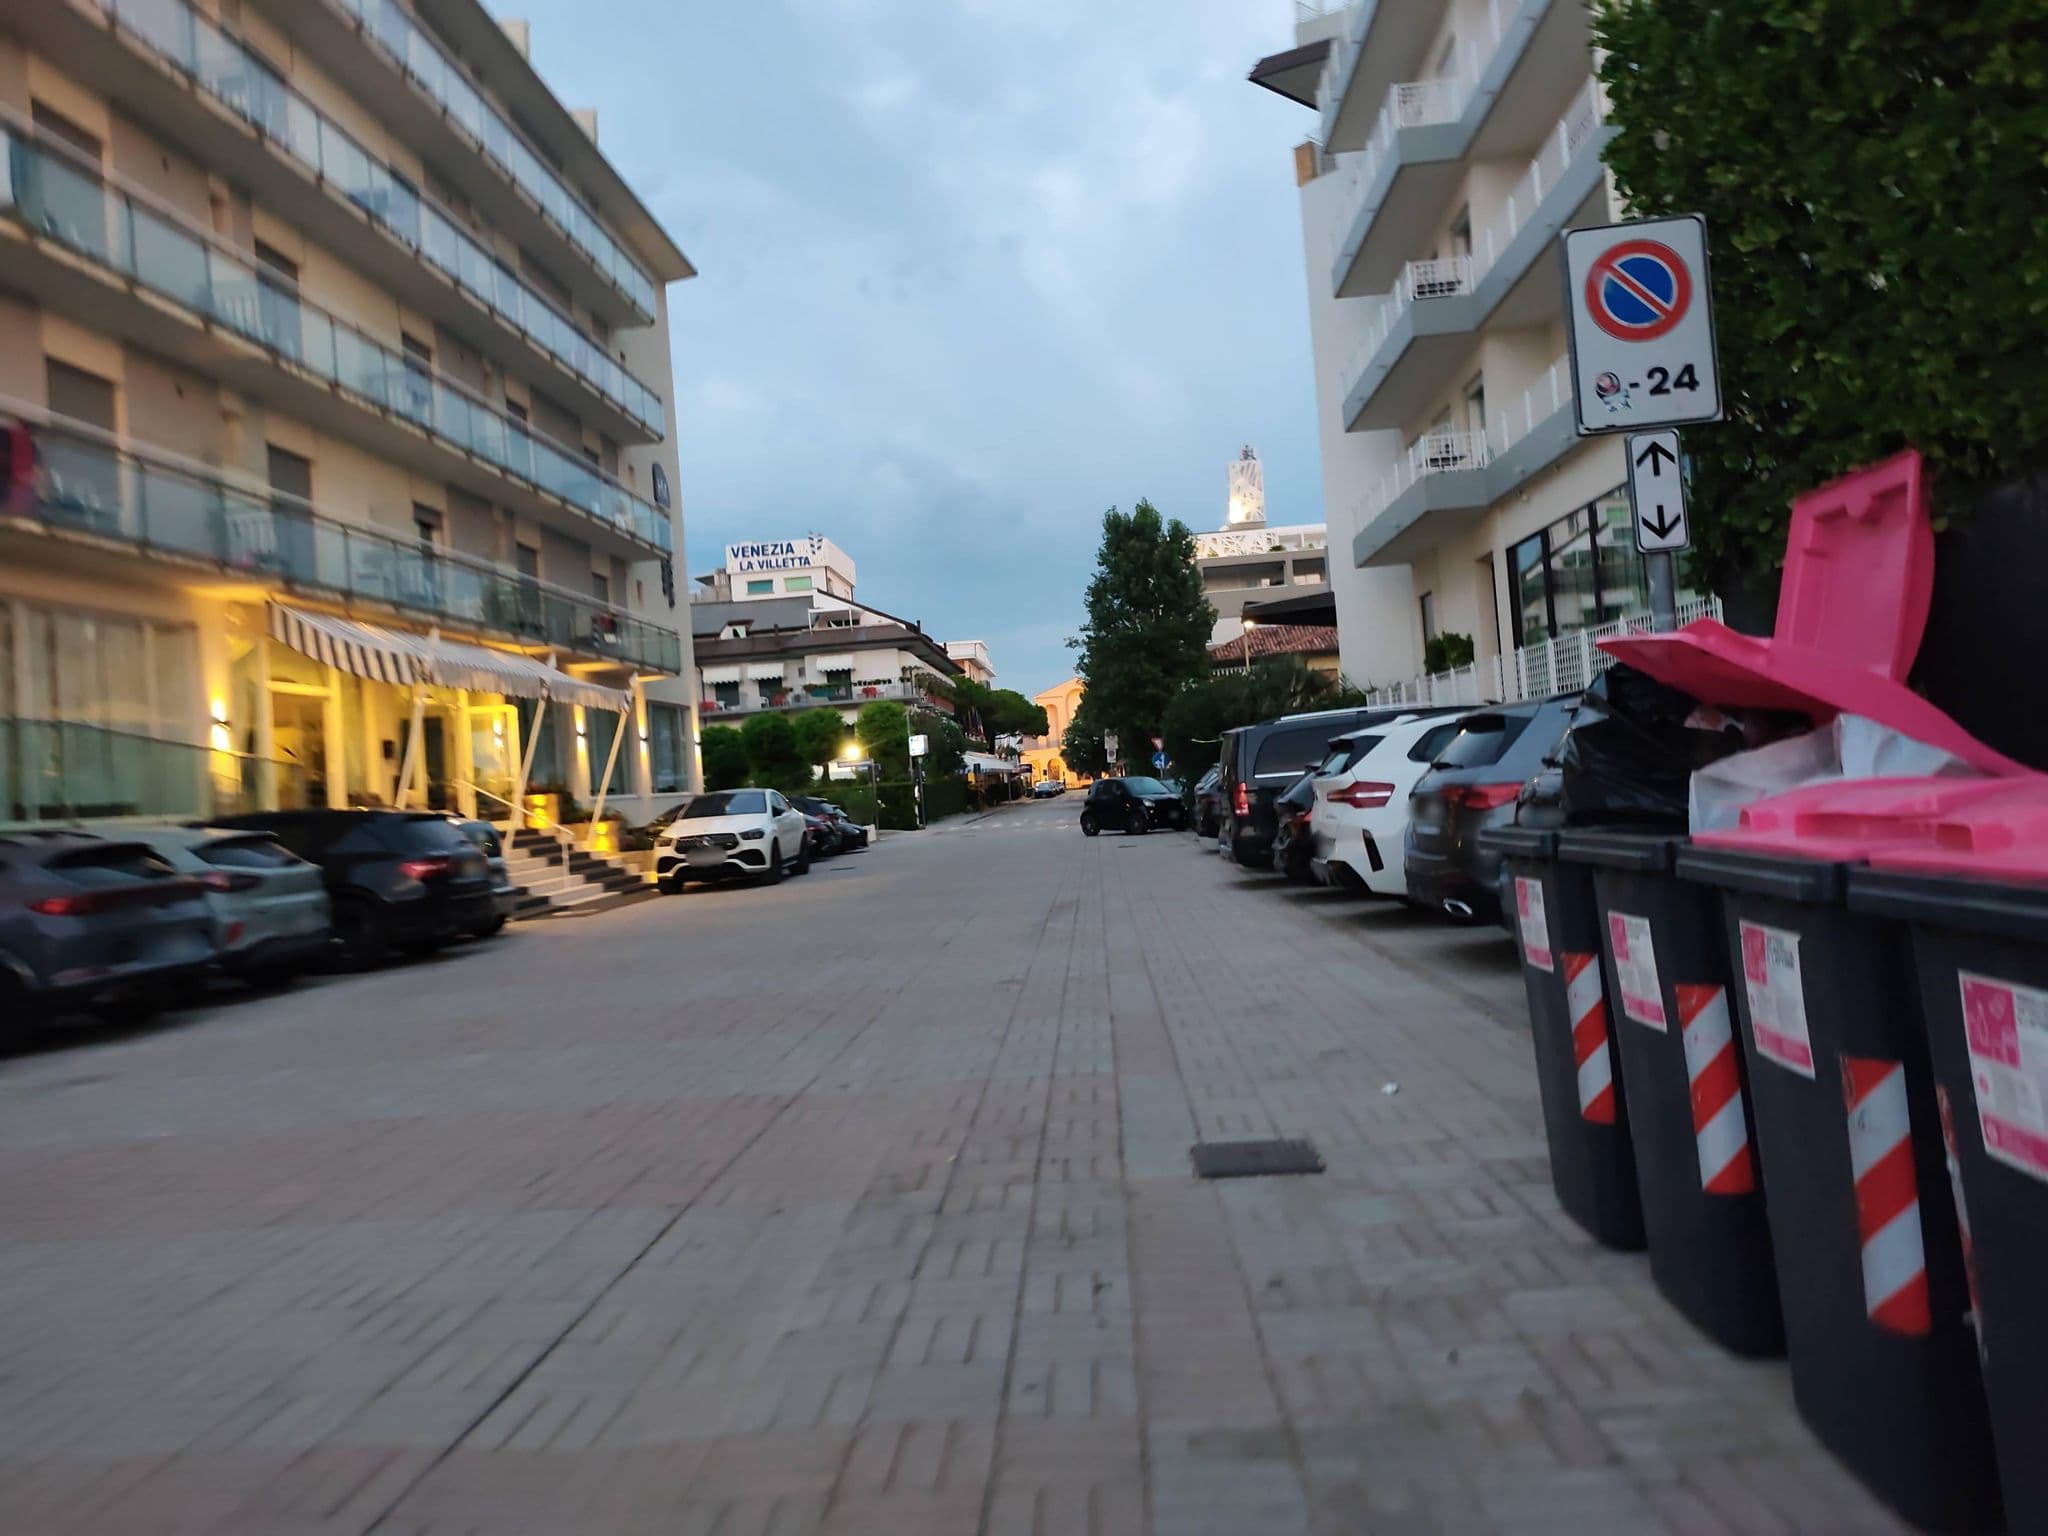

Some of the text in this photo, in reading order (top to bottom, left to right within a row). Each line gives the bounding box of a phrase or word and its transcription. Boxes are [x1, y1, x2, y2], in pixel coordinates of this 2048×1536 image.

[731, 542, 795, 558] VENEZIA
[740, 556, 811, 571] LA VILLETTA
